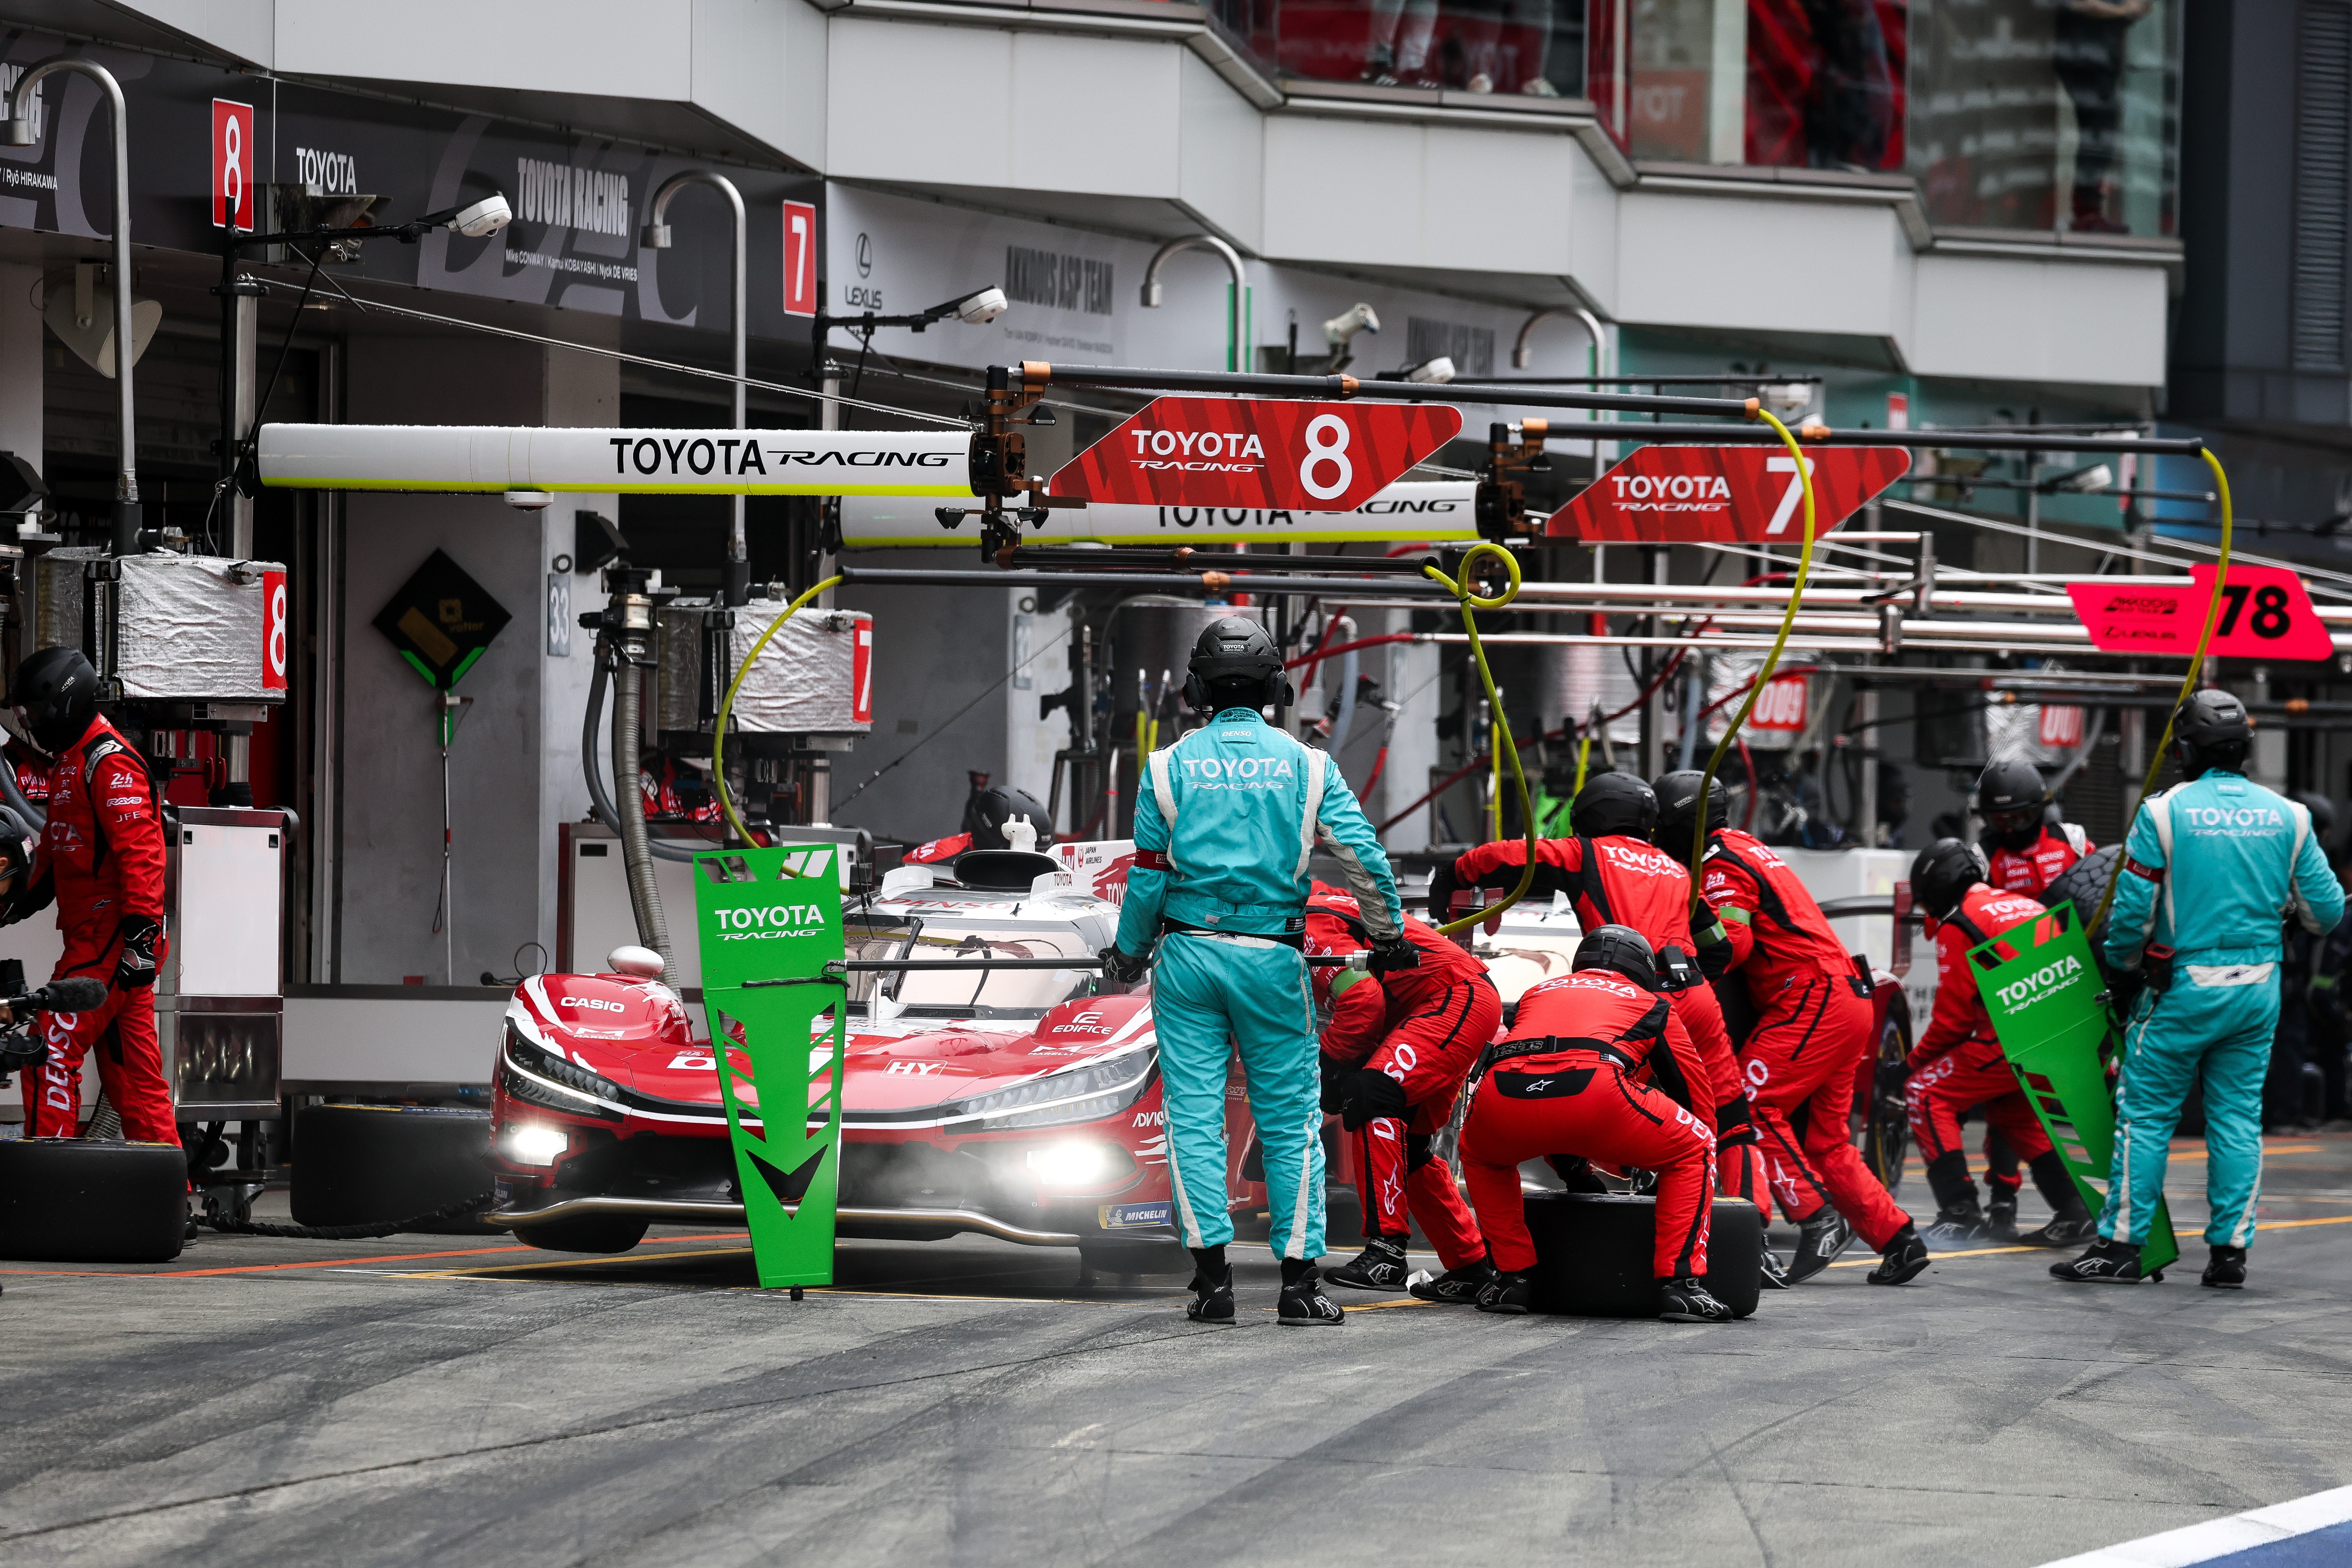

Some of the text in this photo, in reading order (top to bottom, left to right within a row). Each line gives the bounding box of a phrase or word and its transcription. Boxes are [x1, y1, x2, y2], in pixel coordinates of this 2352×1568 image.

[224, 115, 242, 216] 8
[296, 147, 357, 194] TOYOTA
[21, 171, 58, 191] HIRAKAWA
[518, 157, 628, 236] TOYOTA RACING
[506, 248, 519, 263] Mike
[519, 250, 545, 267] CONWAY
[564, 258, 596, 275] KOBAYASHI
[599, 263, 612, 280] Nyck
[613, 265, 621, 279] DE
[622, 267, 637, 282] VRIES
[791, 215, 807, 302] 7
[845, 284, 882, 310] LEXUS
[610, 437, 965, 475] TOYOTA RACING
[1130, 460, 1265, 472] RACING
[1131, 414, 1352, 500] TOYOTA 8
[1612, 456, 1815, 535] TOYOTA 7
[1612, 502, 1731, 512] RACING
[550, 586, 569, 645] 33
[2215, 584, 2291, 639] 78
[270, 584, 286, 677] 8
[859, 630, 873, 712] 7
[1183, 757, 1293, 778] TOYOTA
[1185, 781, 1293, 790] RACING
[107, 797, 142, 807] RAYS
[1674, 796, 1692, 807] TOYOTA
[116, 811, 141, 822] JFE
[2185, 808, 2284, 827] TOYOTA
[2189, 829, 2284, 837] RACING
[1085, 846, 1097, 855] JAPAN
[1085, 856, 1102, 865] AIRLINES
[1601, 845, 1684, 873] TOYOTA
[1054, 873, 1072, 887] TOYOTA
[715, 904, 825, 929] TOYOTA
[716, 928, 825, 941] RACING
[1538, 978, 1636, 998] TOYOTA
[1995, 955, 2082, 1007] TOYOTA
[1533, 985, 1635, 999] RACING
[2003, 971, 2085, 1015] RACING
[560, 996, 626, 1013] CASIO
[1051, 1025, 1113, 1035] EDIFICE
[45, 1011, 78, 1111] DENSO
[887, 1062, 941, 1076] HY
[1132, 1111, 1165, 1127] ADVIC
[1125, 1209, 1167, 1221] MICHELIN
